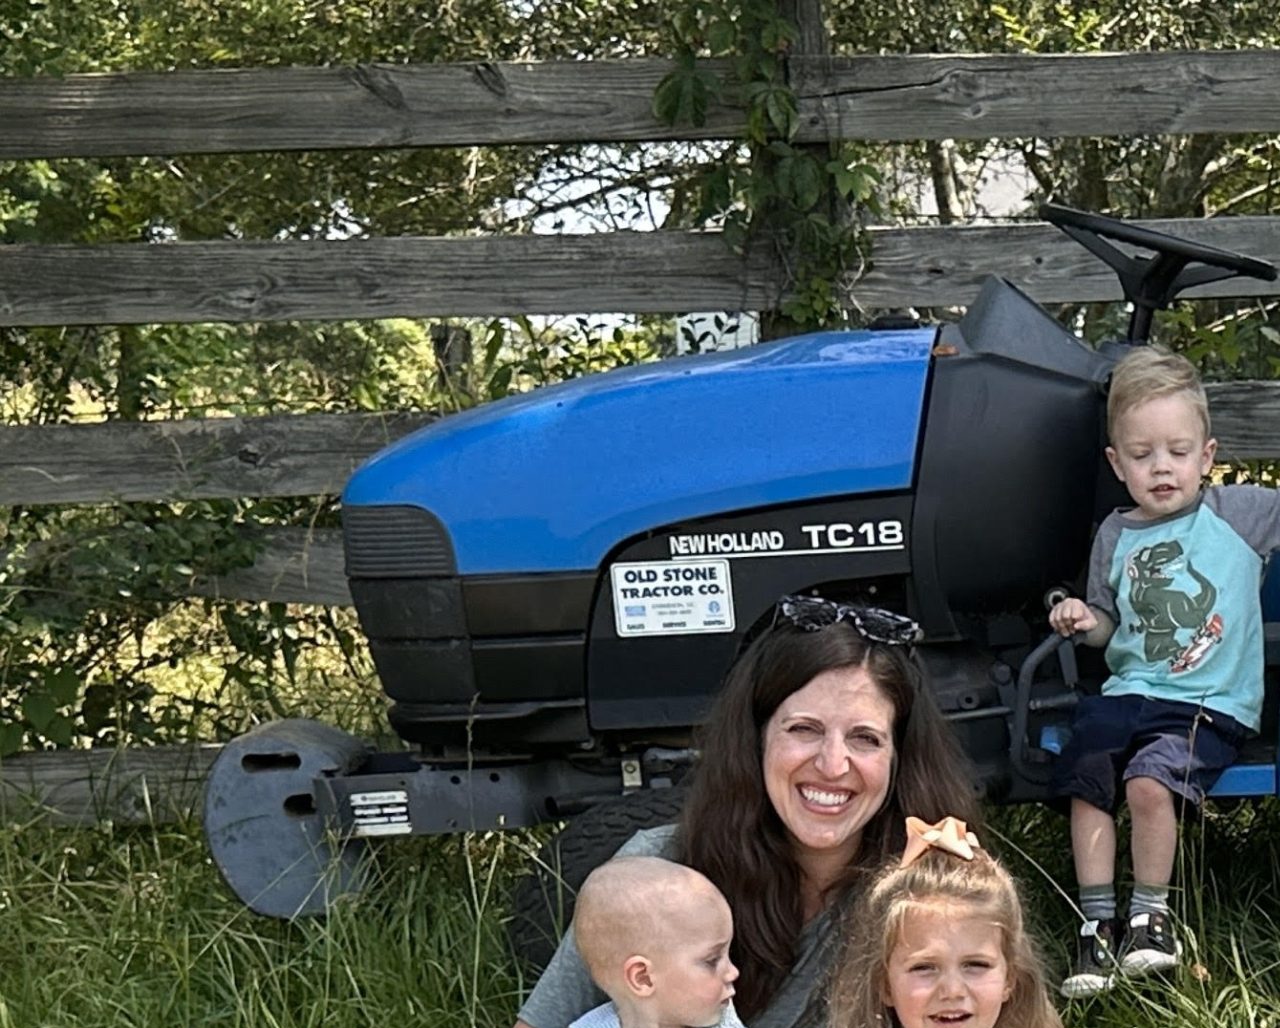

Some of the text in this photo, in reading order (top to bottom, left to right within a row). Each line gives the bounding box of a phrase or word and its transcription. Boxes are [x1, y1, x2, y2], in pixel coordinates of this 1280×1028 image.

[669, 519, 905, 555] NEW HOLLAND TC18
[624, 566, 718, 583] OLD STONE
[620, 583, 725, 599] TRACTOR CO.
